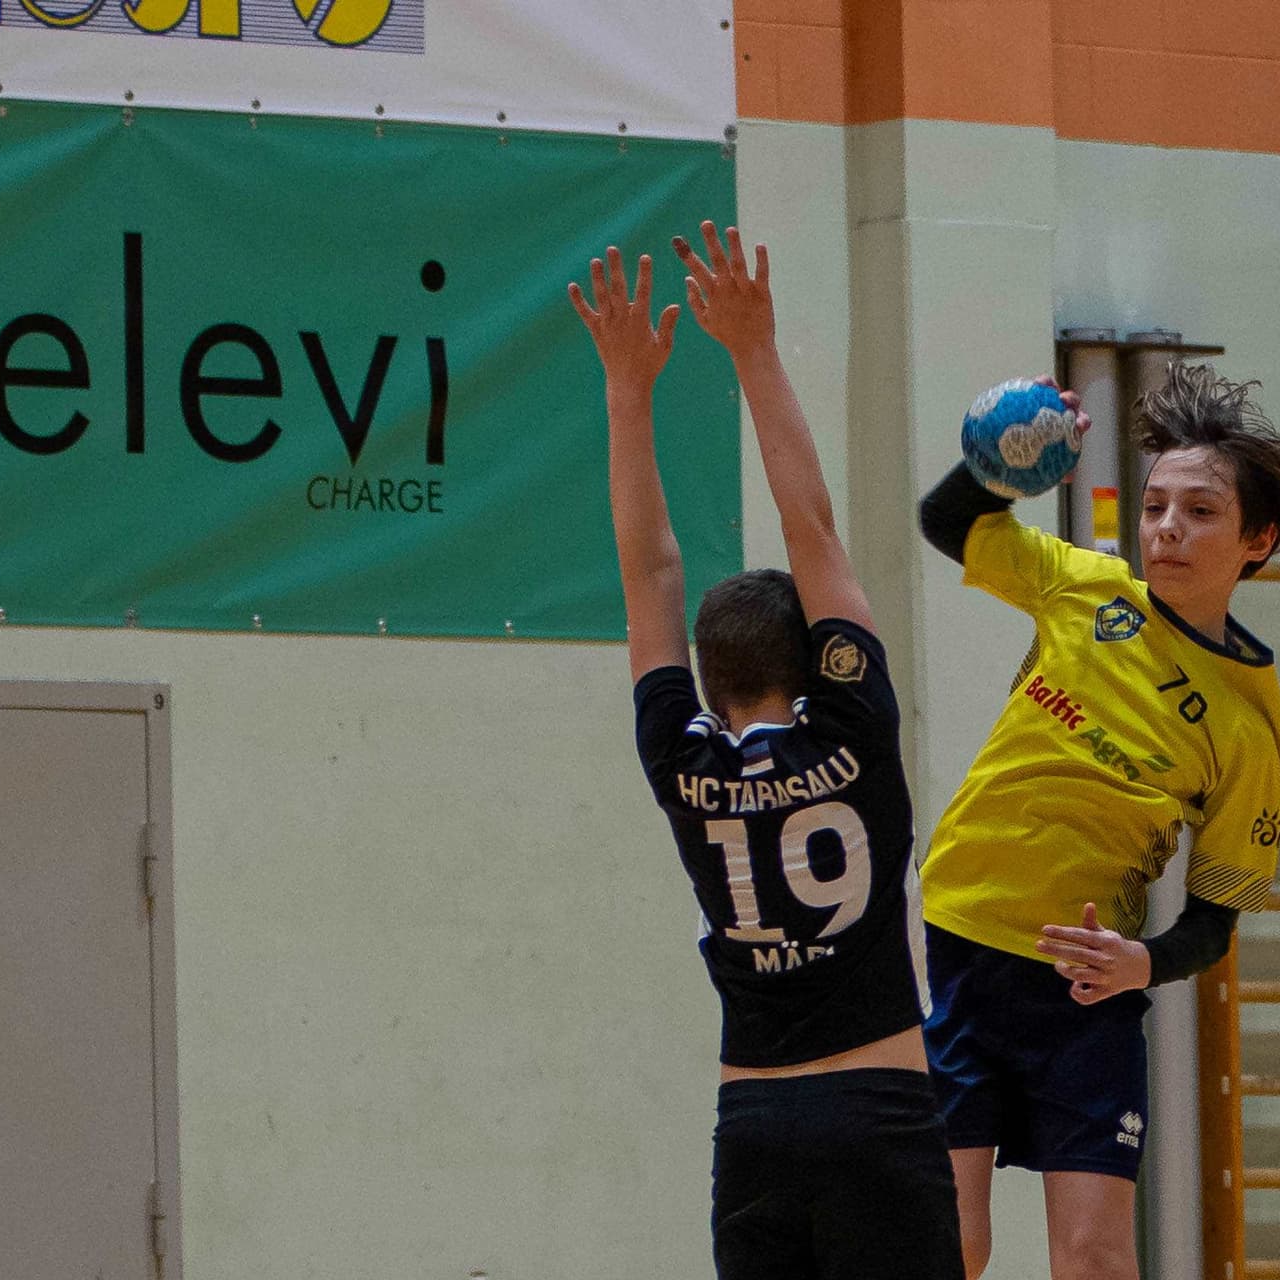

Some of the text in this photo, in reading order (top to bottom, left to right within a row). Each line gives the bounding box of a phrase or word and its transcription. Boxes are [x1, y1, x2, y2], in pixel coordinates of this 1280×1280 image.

[306, 475, 444, 514] CHARGE
[153, 693, 165, 711] 9
[1156, 663, 1208, 724] 70
[1024, 674, 1141, 781] Baltic Agro
[677, 773, 720, 812] HC
[704, 801, 872, 943] 19
